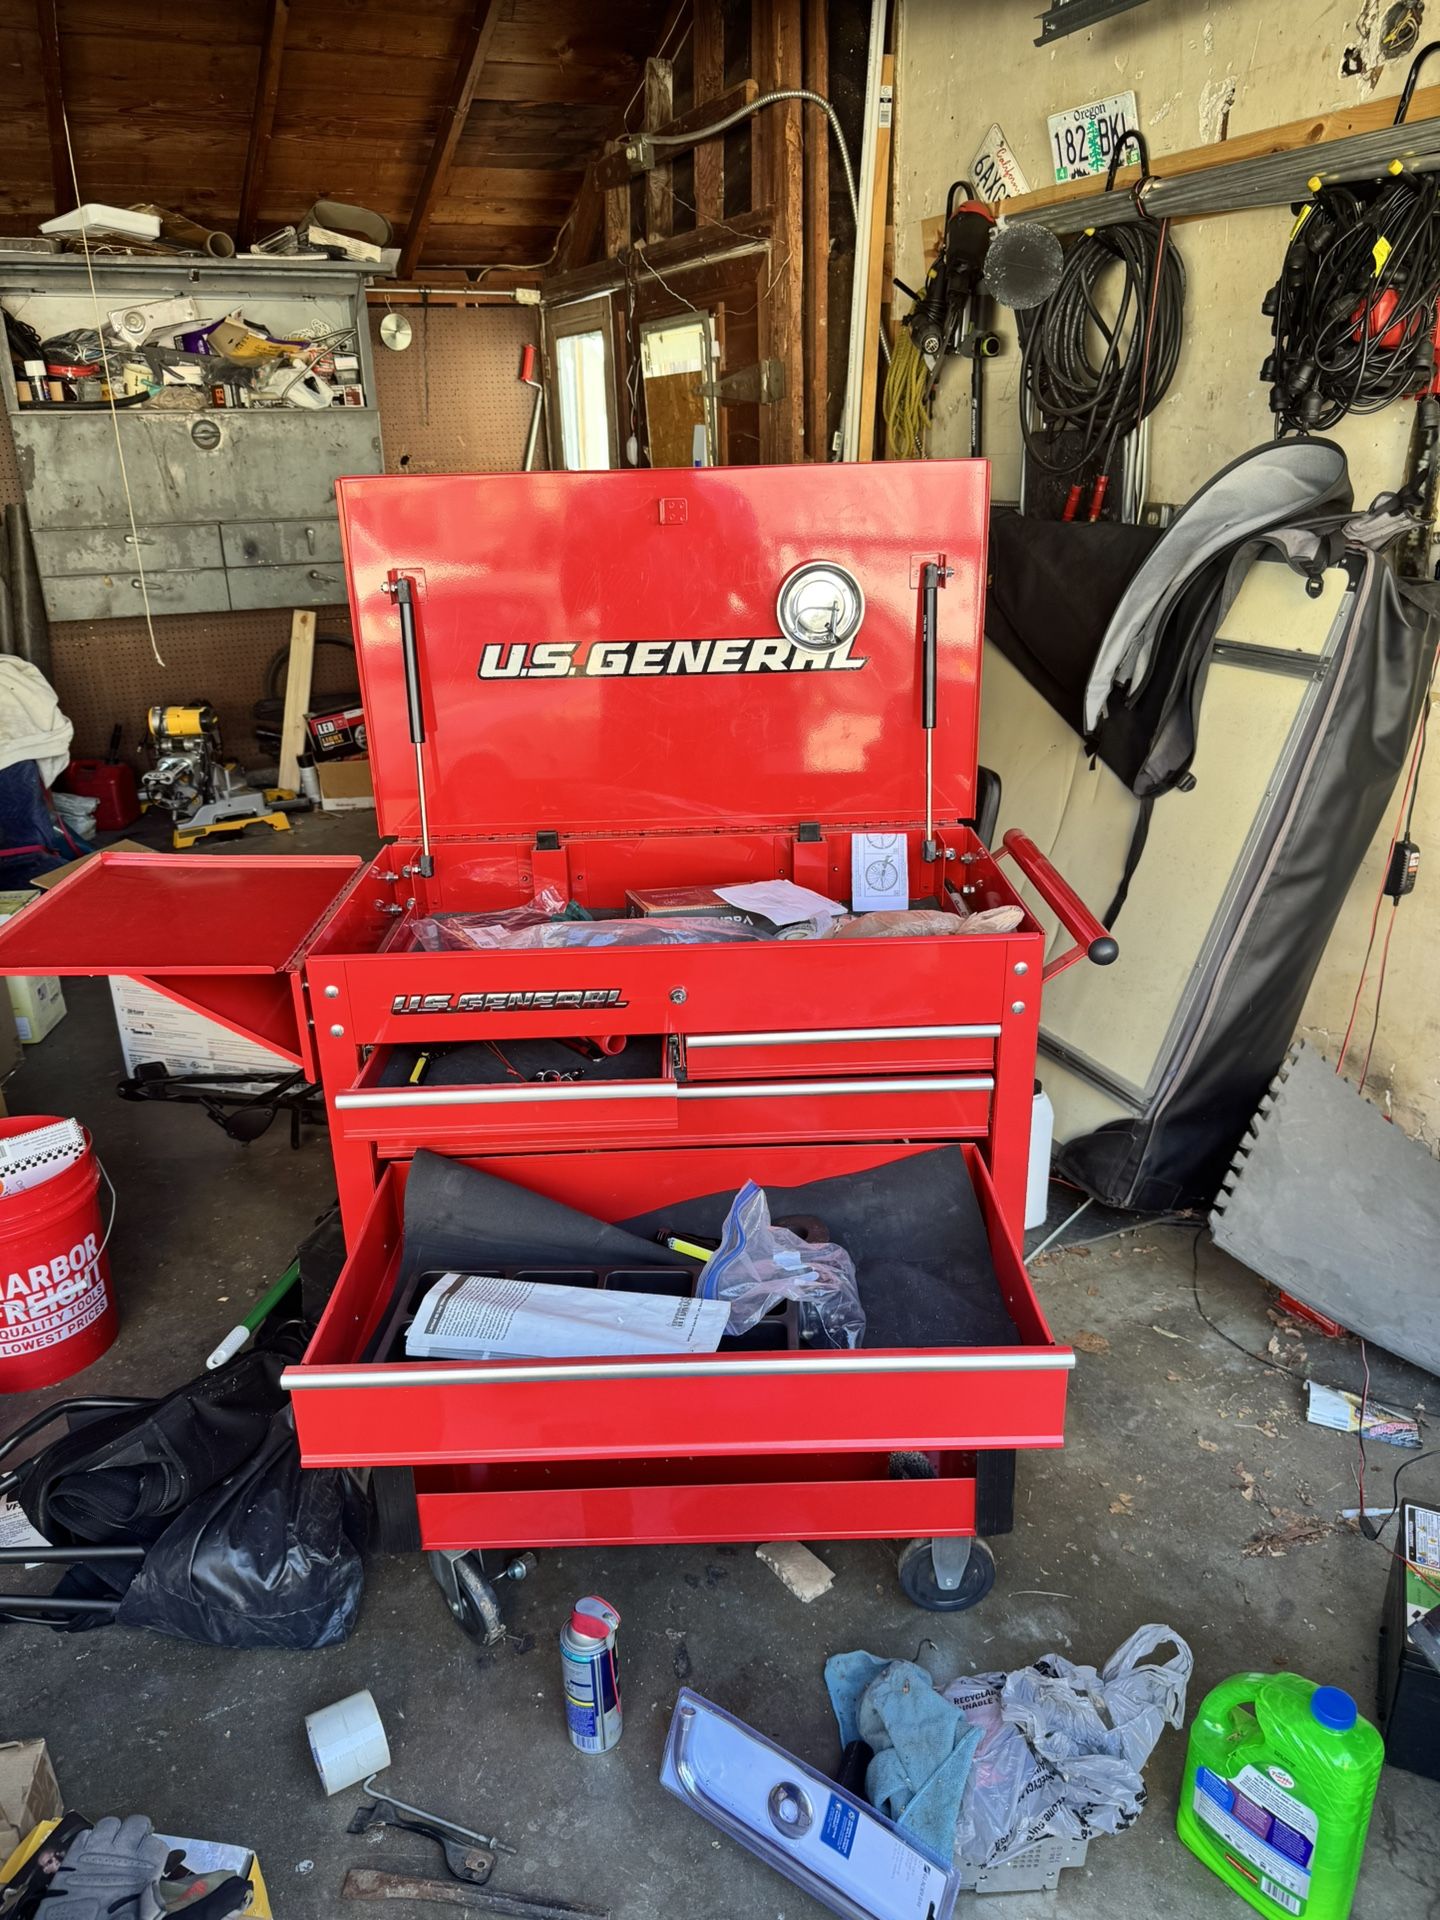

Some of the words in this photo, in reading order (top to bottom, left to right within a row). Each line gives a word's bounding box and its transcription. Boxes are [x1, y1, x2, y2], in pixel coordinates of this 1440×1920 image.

[1073, 103, 1106, 123] Oregon
[1054, 124, 1089, 168] 182
[317, 721, 336, 735] LED
[0, 1260, 100, 1326] REIGHT
[70, 1286, 104, 1316] TOOLS
[3, 1329, 63, 1355] LOWEST
[67, 1298, 106, 1335] PRICES
